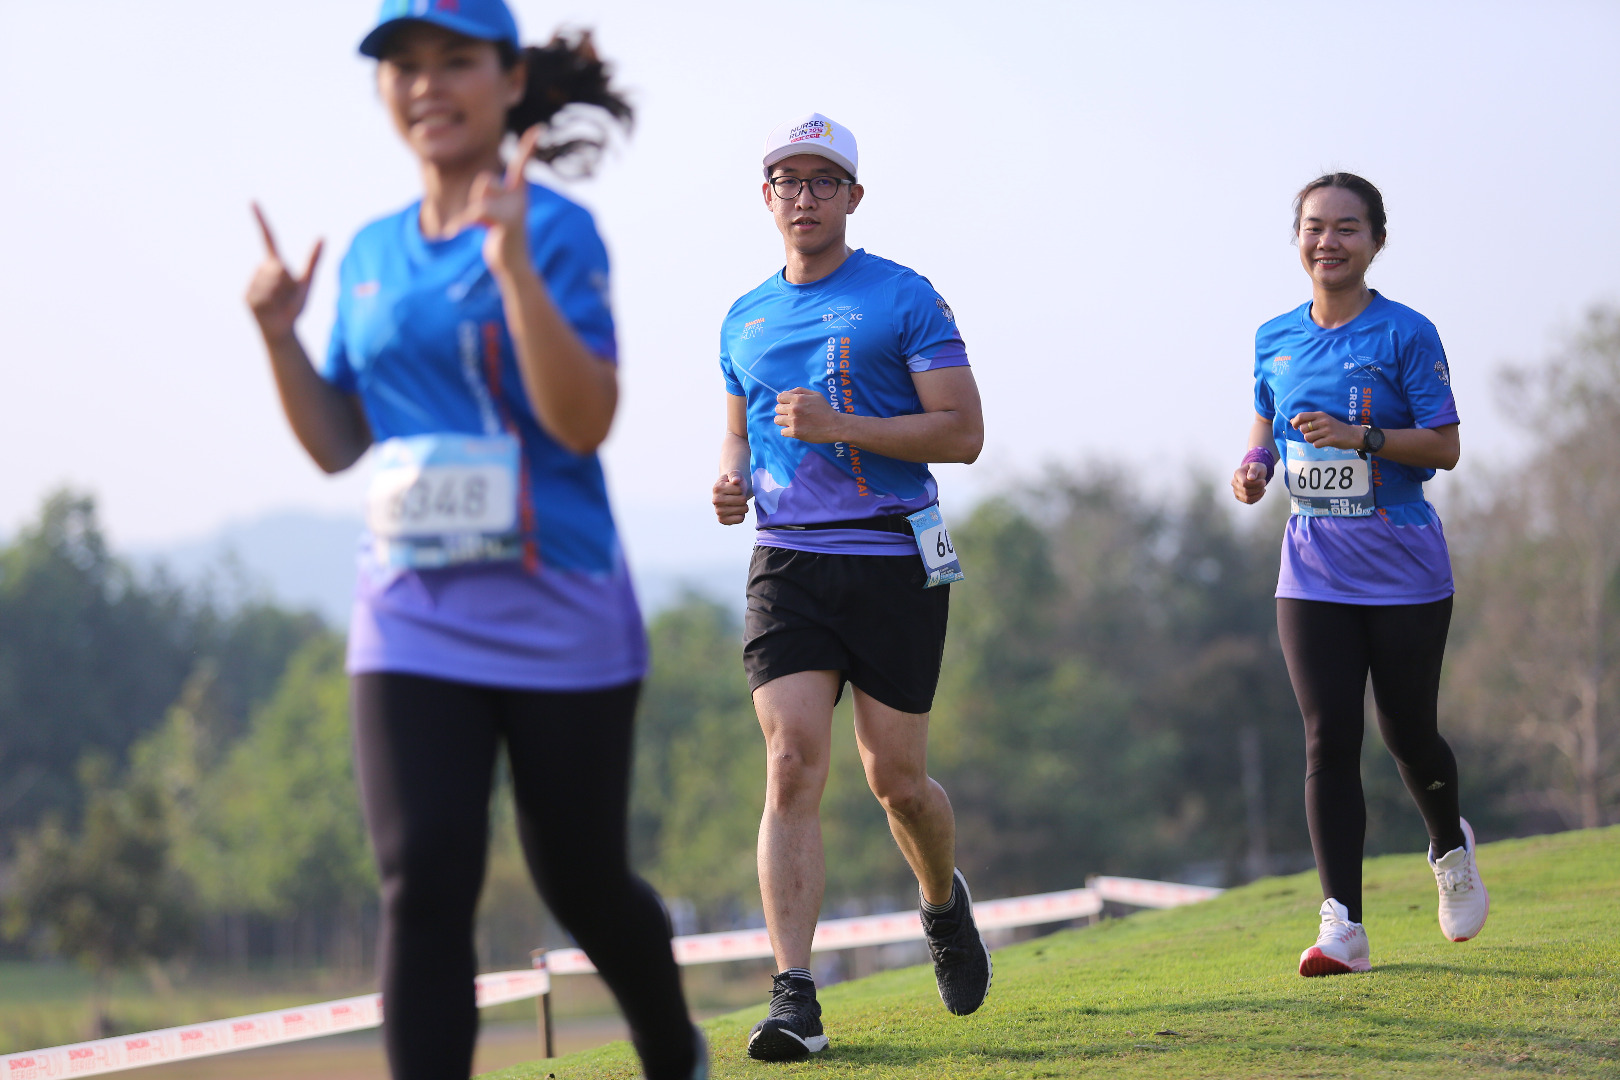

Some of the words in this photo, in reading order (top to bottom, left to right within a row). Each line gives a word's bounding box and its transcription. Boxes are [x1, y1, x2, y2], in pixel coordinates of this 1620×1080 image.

[789, 129, 808, 140] RUN
[790, 120, 824, 133] NURSES
[821, 313, 834, 322] SP
[849, 313, 863, 321] XC
[840, 337, 851, 387] SINGHA
[1343, 361, 1355, 370] SP
[826, 336, 836, 375] CROSS
[834, 441, 845, 458] UN
[842, 389, 855, 413] PAR
[1348, 386, 1358, 422] CROSS
[1360, 387, 1372, 425] SINGH
[855, 476, 869, 497] RAI
[1298, 466, 1354, 490] 6028
[1351, 503, 1363, 515] 16
